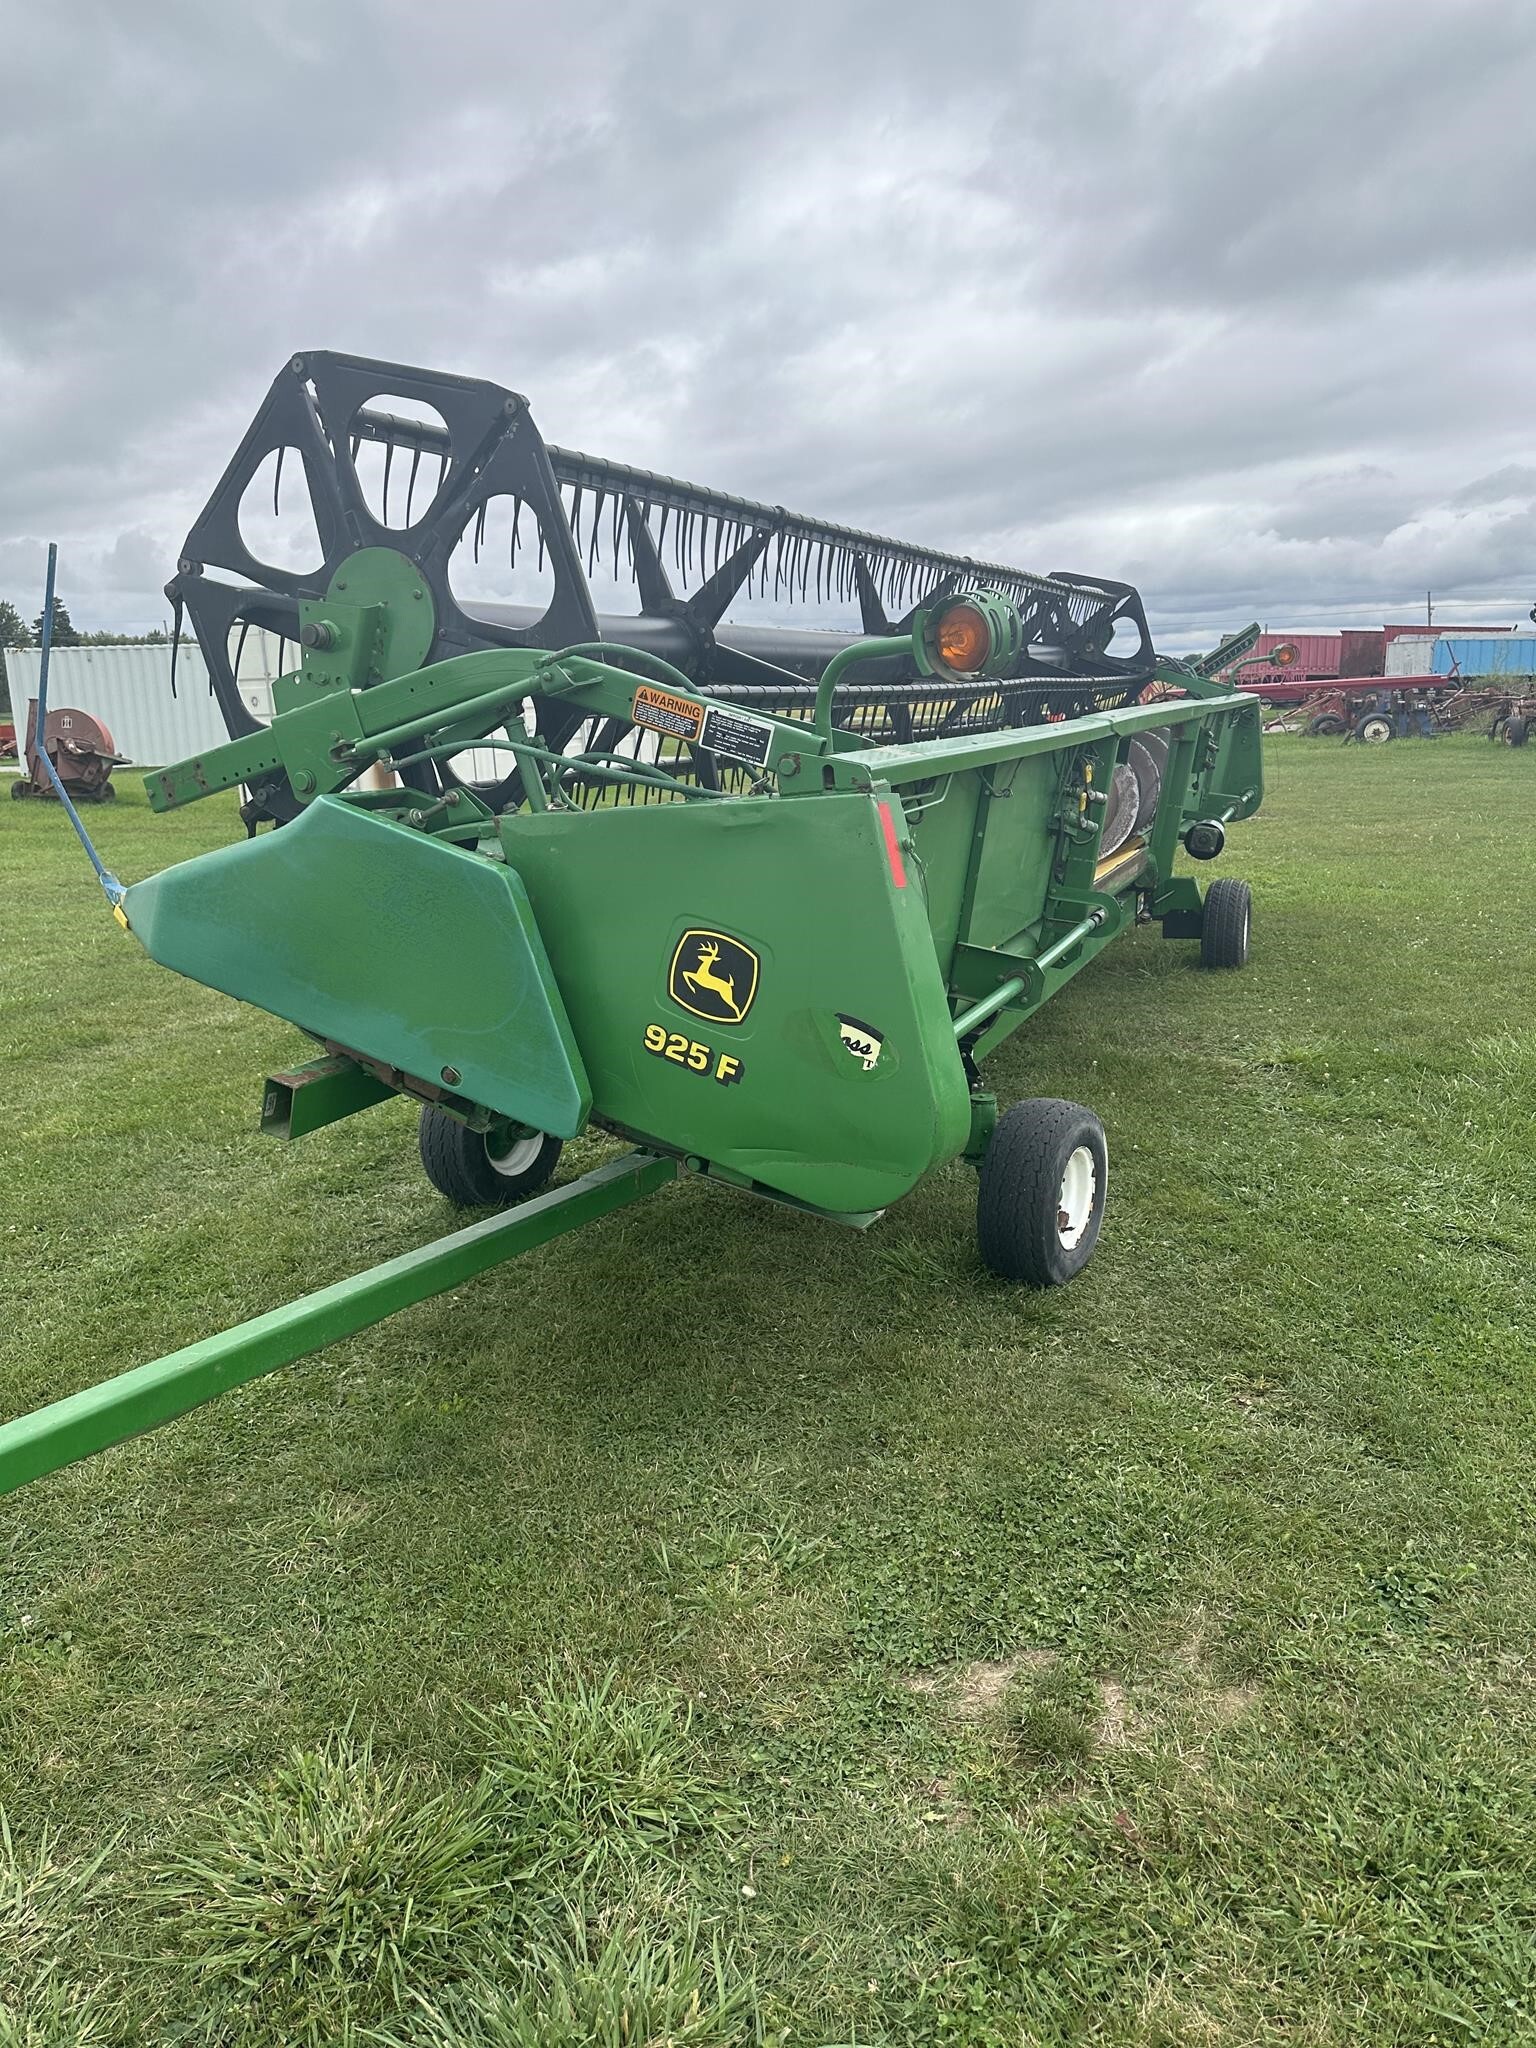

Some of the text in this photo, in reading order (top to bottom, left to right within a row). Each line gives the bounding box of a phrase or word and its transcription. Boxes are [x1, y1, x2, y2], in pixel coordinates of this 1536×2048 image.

[650, 692, 700, 718] WARNING
[643, 1024, 743, 1085] 925 F
